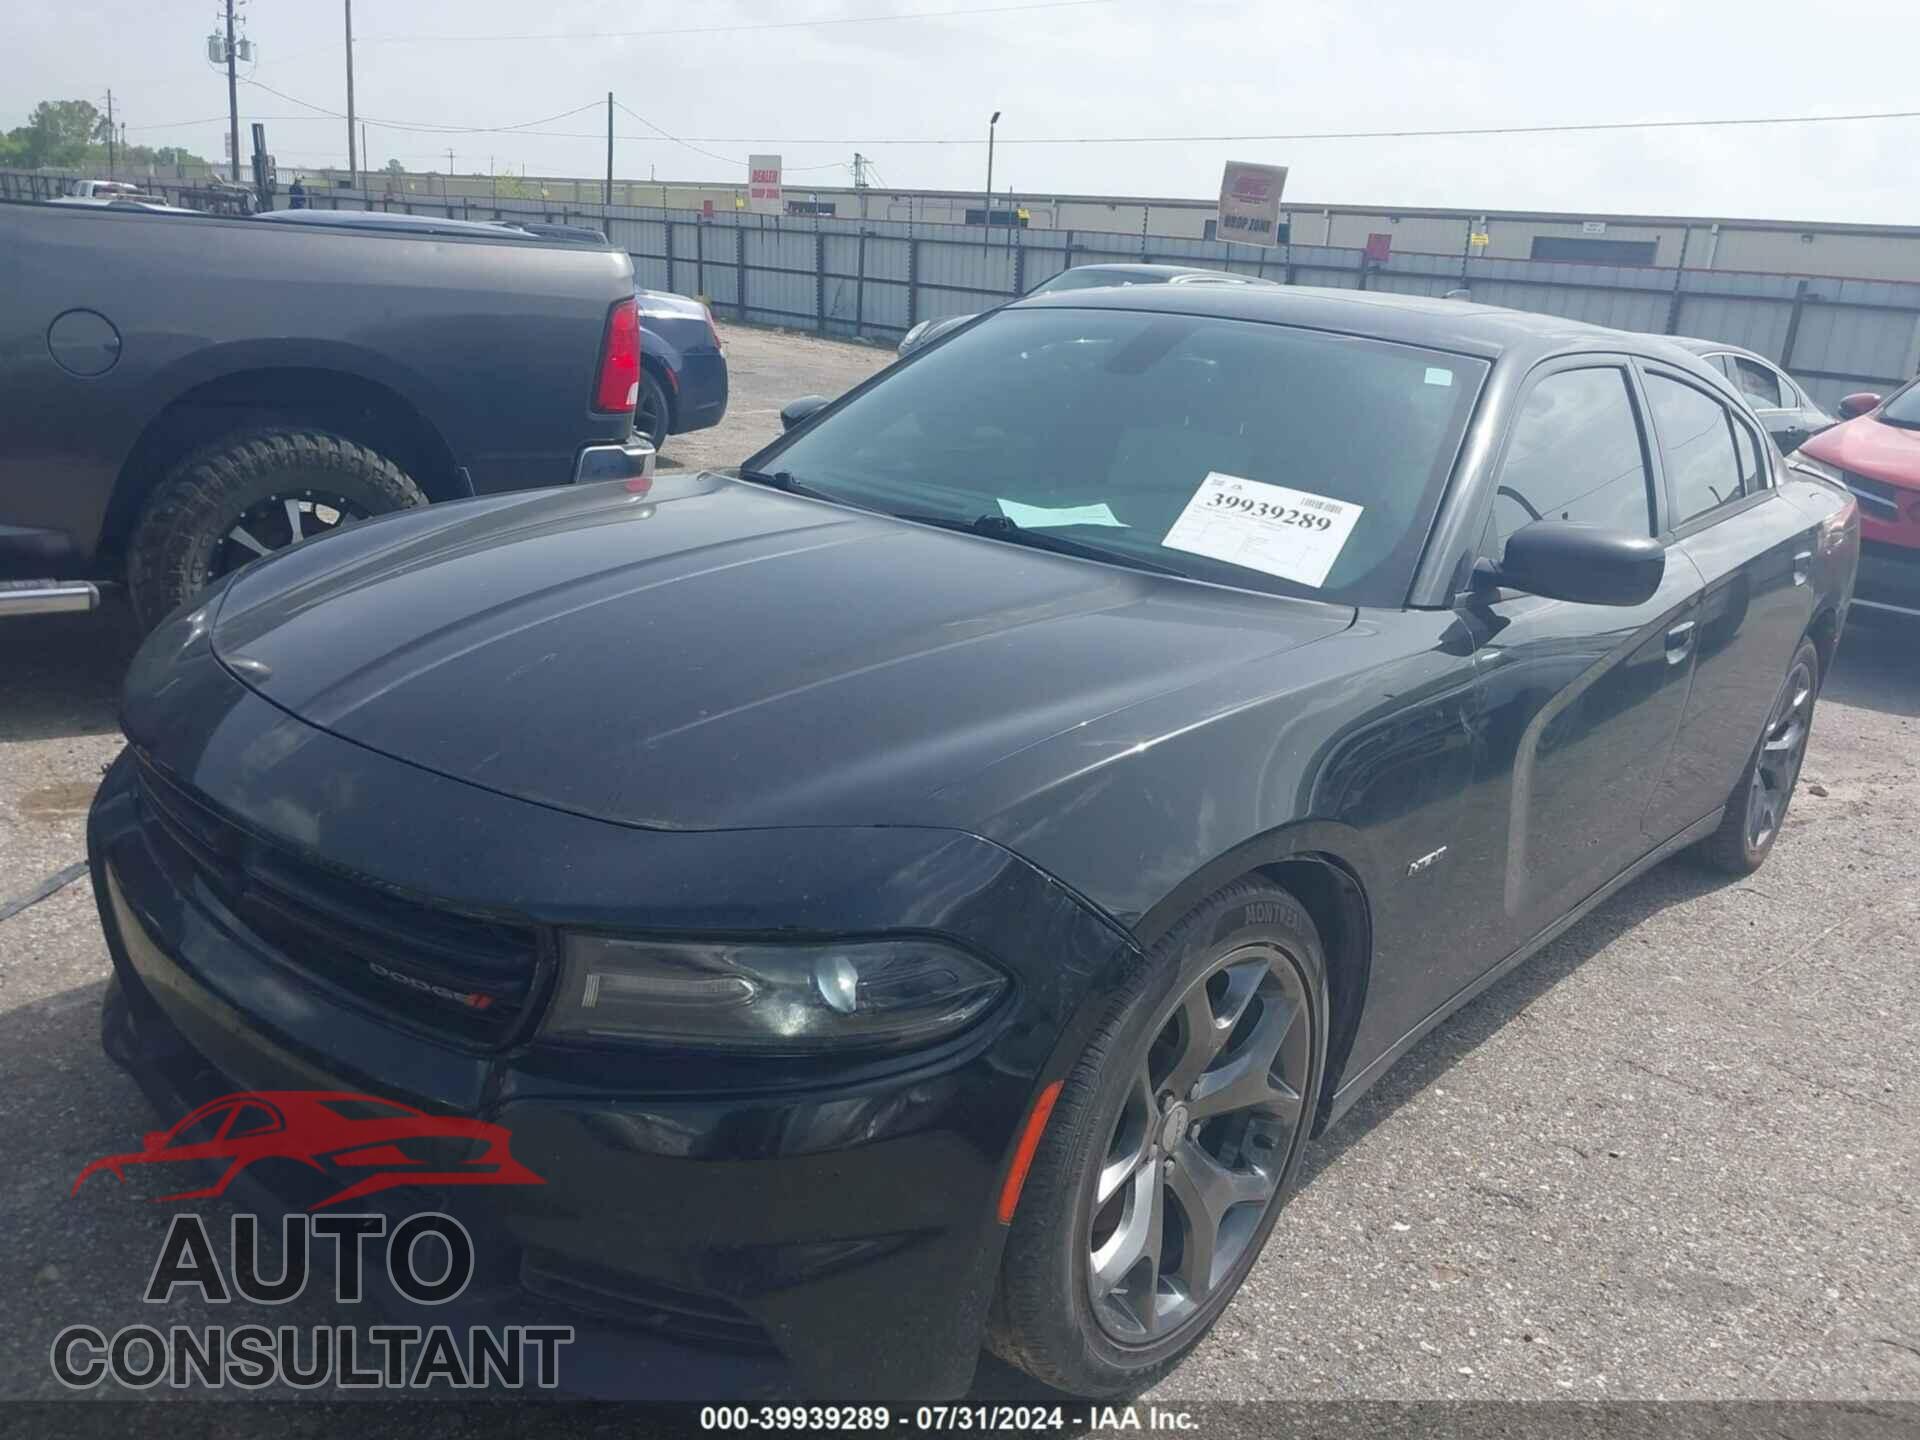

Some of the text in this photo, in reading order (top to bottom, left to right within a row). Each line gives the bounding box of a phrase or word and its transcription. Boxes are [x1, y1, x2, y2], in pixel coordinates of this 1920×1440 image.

[752, 169, 779, 183] DEALER
[1223, 214, 1272, 233] DROP ZONE
[1207, 492, 1332, 532] 39939289
[369, 962, 467, 1003] DODGE
